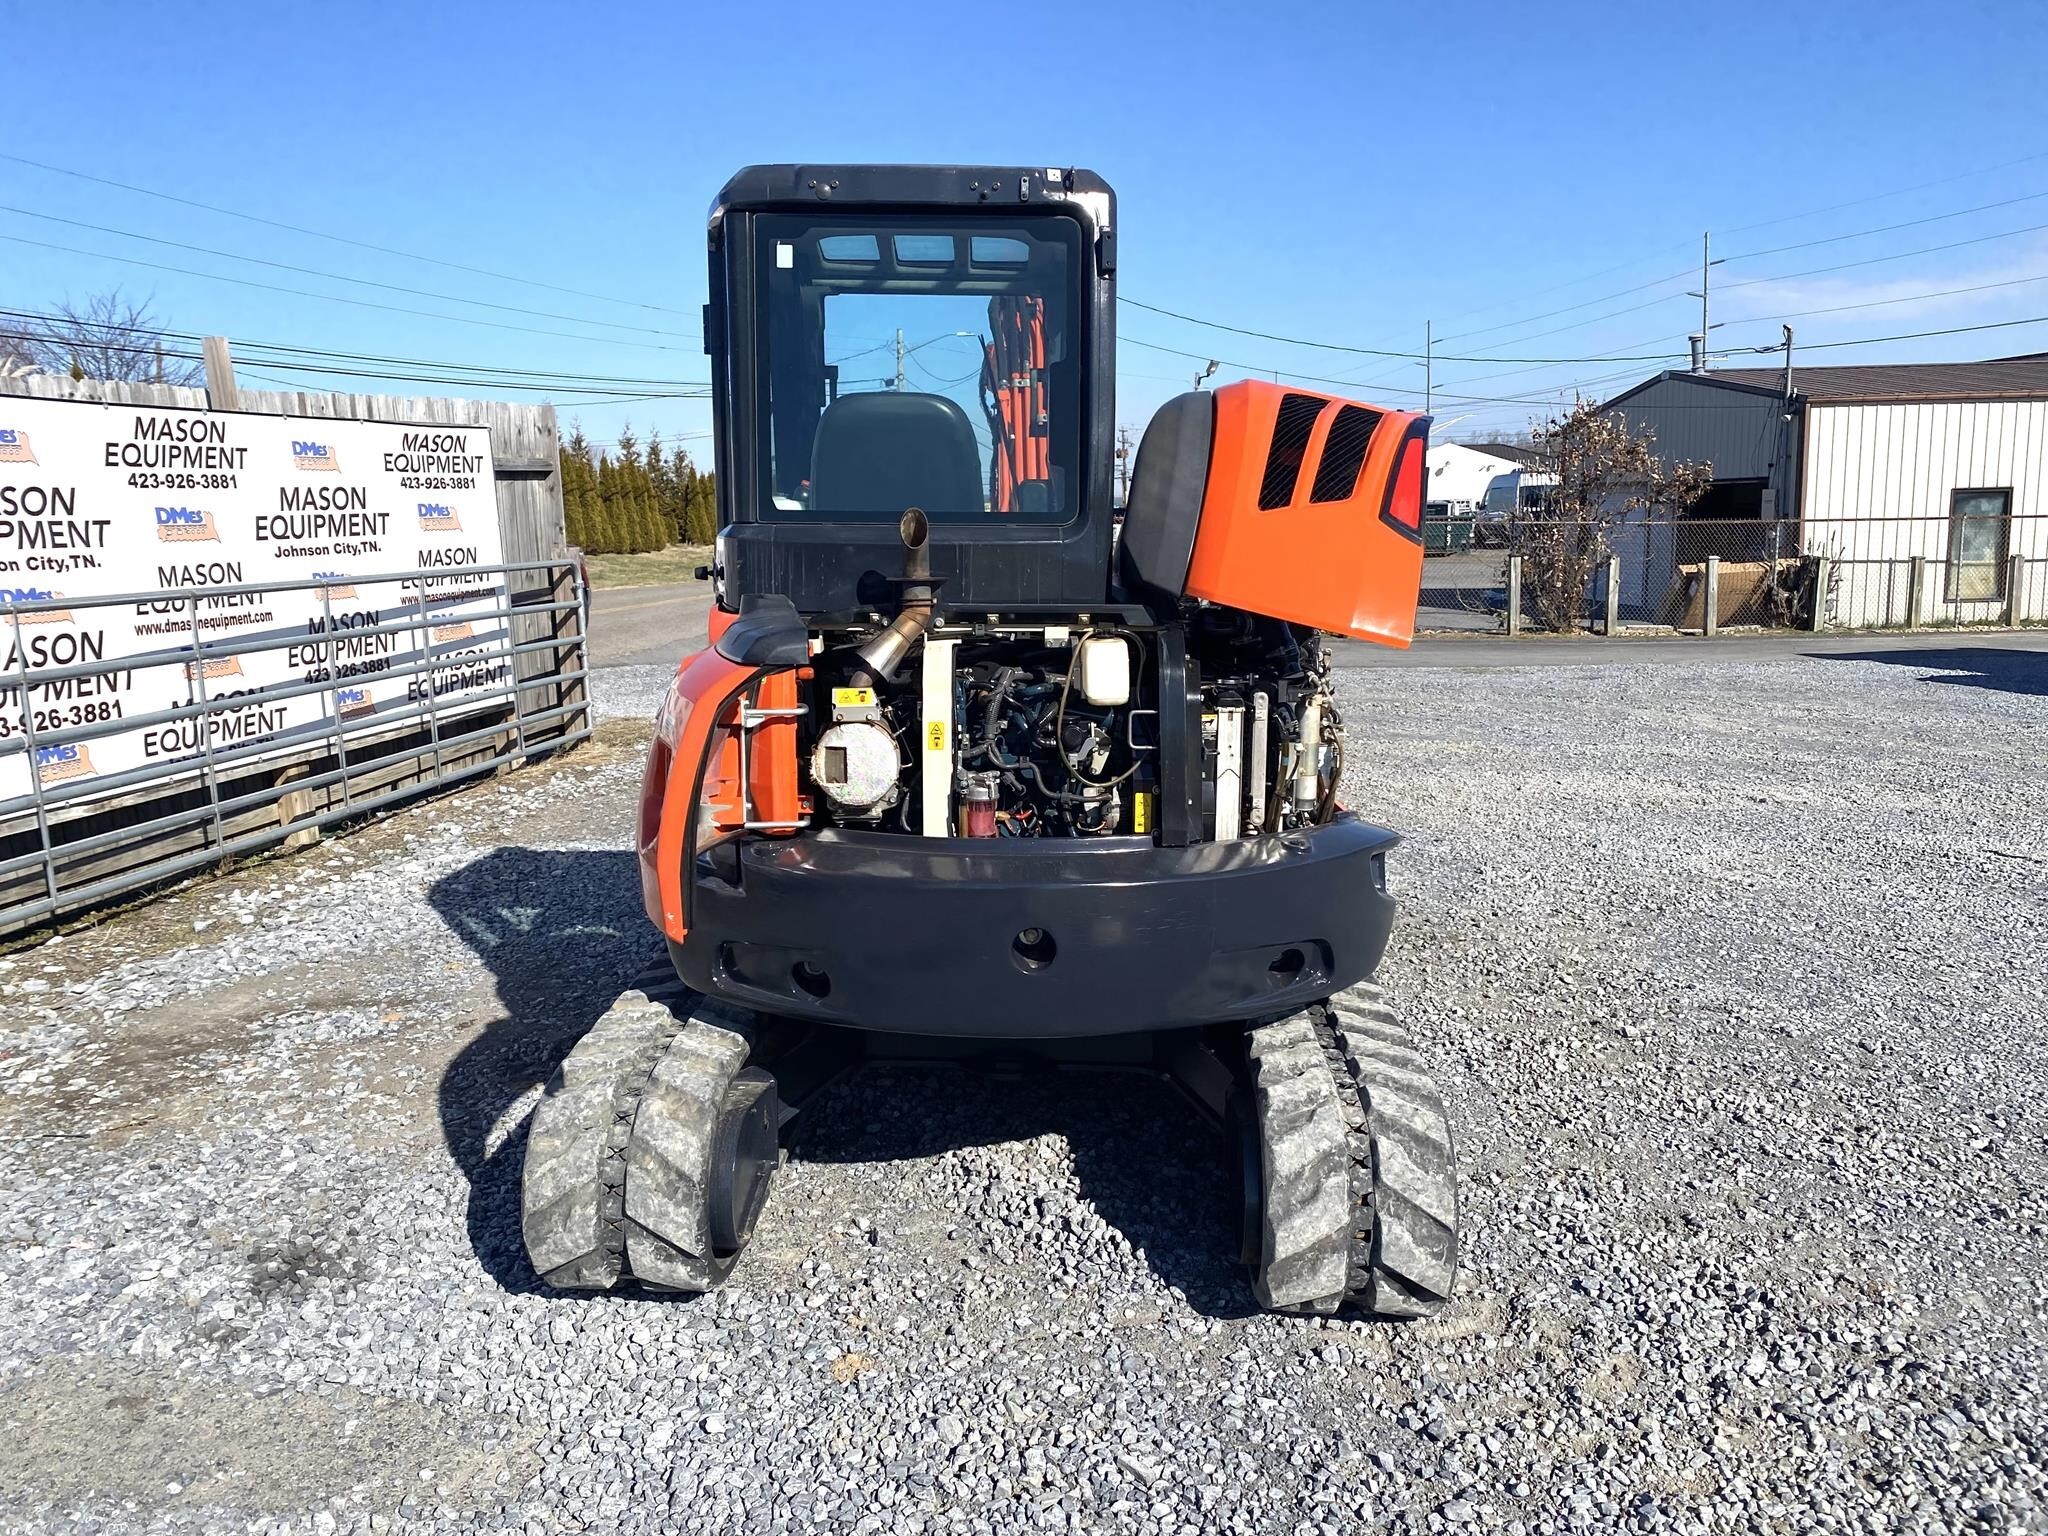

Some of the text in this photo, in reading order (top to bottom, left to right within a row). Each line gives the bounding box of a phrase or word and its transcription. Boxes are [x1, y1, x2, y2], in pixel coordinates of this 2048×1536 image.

[134, 416, 226, 444] MASON
[402, 433, 467, 453] MASON
[105, 442, 248, 470] EQUIPMENT
[383, 453, 484, 474] EQUIPMENT
[128, 472, 238, 489] 423-926-3881
[400, 476, 476, 490] 423-926-3881
[0, 486, 75, 516] SON
[279, 486, 367, 512] MASON
[255, 512, 390, 541] EQUIPMENT
[274, 541, 382, 558] Johnson City,TN.
[418, 547, 477, 568] MASON
[26, 554, 102, 573] City,TN.
[158, 562, 242, 588] MASON
[400, 587, 496, 605] wwwmasonequipment.com
[134, 611, 273, 636] www.dmasnequipment.com
[288, 632, 399, 668] EQUPMENT
[304, 657, 391, 684] 42326-3881
